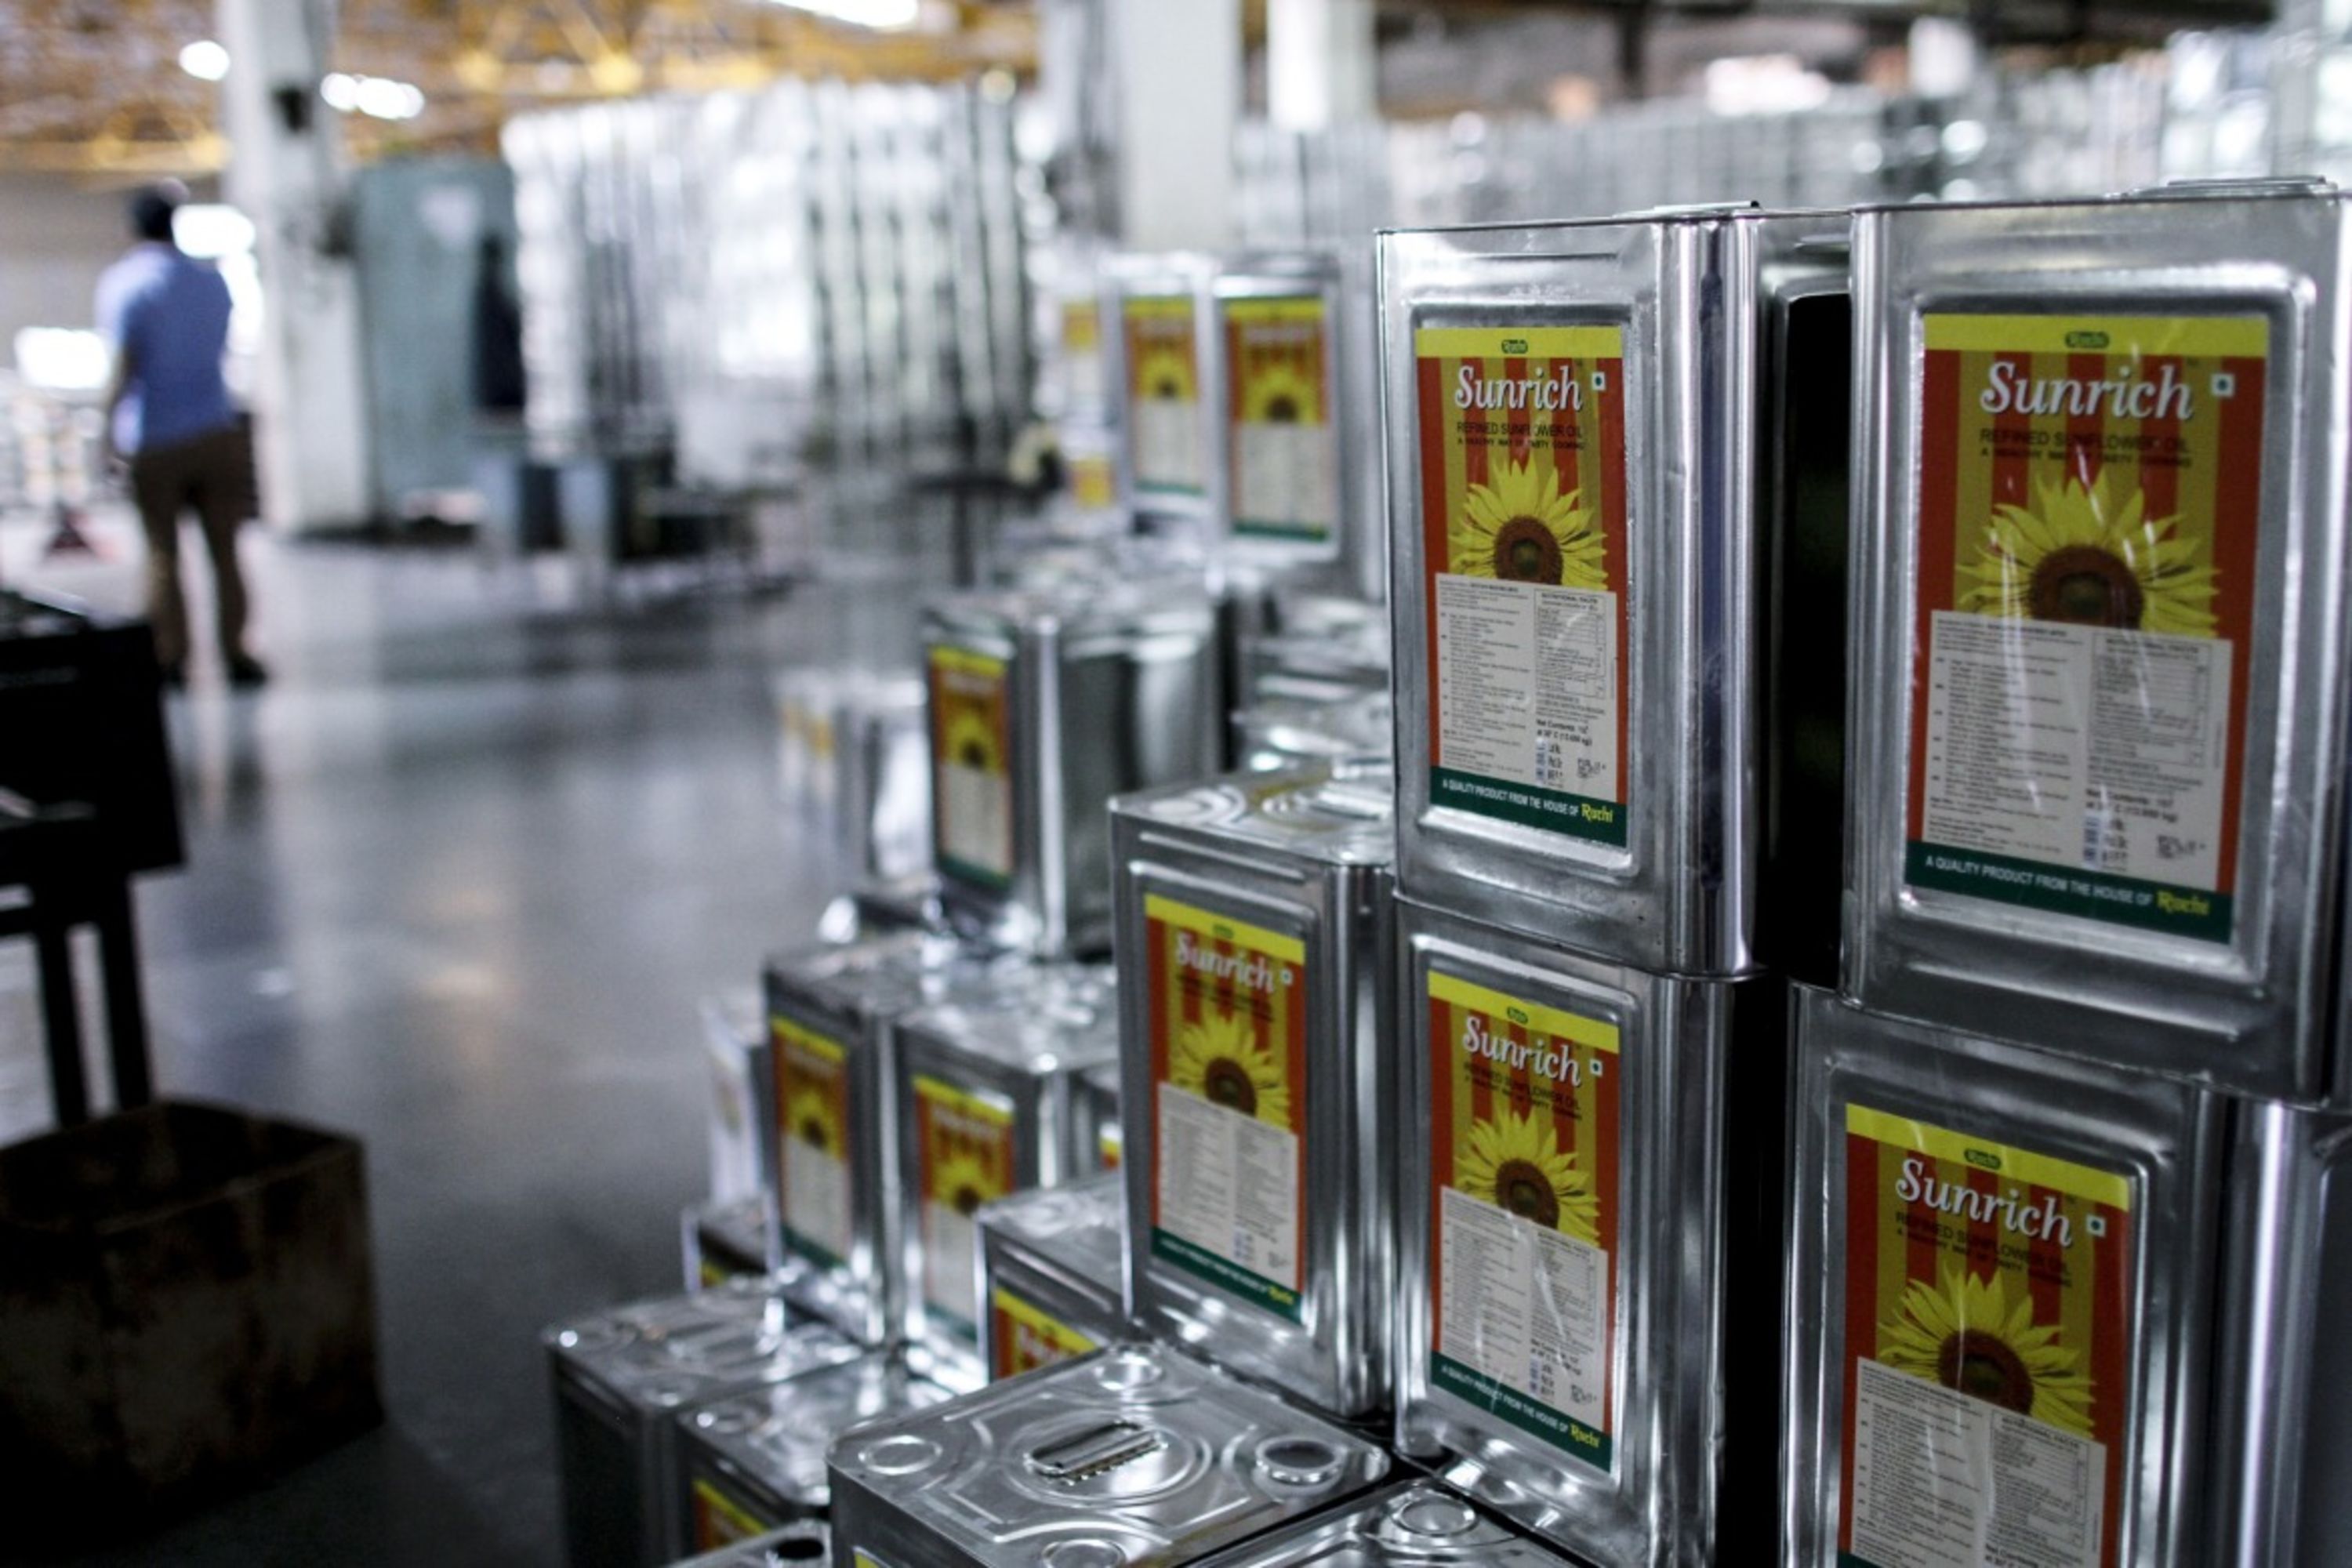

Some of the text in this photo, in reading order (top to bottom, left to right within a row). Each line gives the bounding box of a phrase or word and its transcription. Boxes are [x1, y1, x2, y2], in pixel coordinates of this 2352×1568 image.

[1454, 363, 1582, 411] Sunrich
[1980, 361, 2193, 419] Sunrich
[1509, 790, 1529, 805] FROM
[1530, 794, 1541, 808] THE
[1543, 798, 1569, 815] HOUSE
[1926, 855, 1936, 868] A
[1936, 858, 1980, 877] QUALITY
[1982, 865, 2033, 885] PRODUCT
[2034, 873, 2067, 891] FROM
[2070, 880, 2090, 896] THE
[2092, 884, 2133, 904] HOUSE
[2135, 891, 2153, 907] OF
[1176, 933, 1275, 994] Sunrich
[1463, 1015, 1581, 1087] Sunrich
[1895, 1158, 2071, 1247] Sunrich
